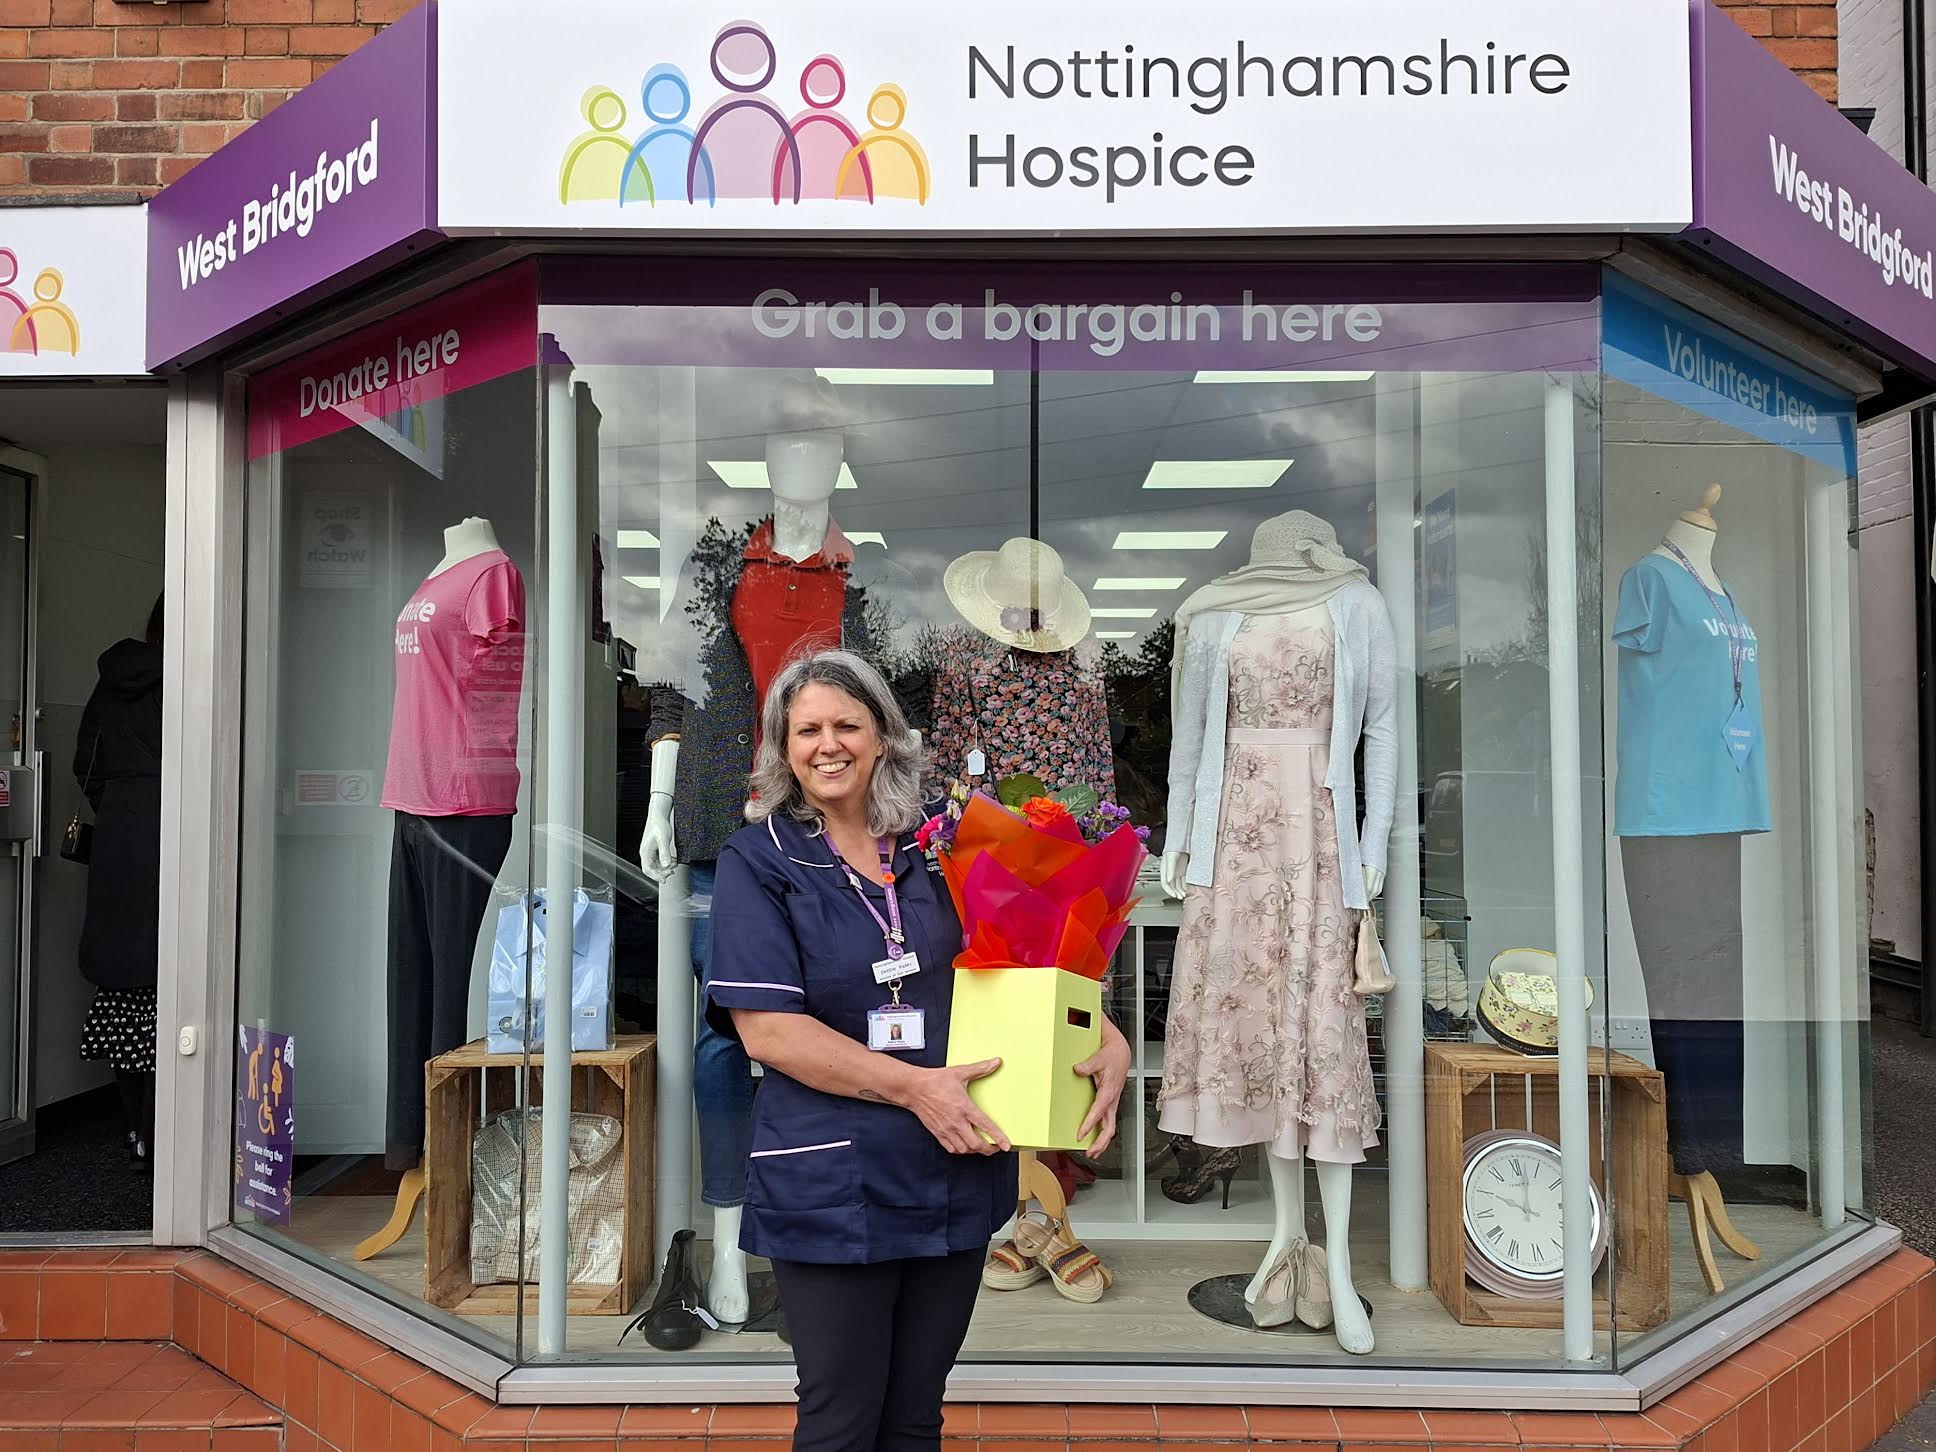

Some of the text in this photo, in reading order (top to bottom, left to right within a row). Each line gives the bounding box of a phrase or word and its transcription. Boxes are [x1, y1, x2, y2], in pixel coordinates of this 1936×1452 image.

[969, 39, 1570, 114] Nottinghamshire
[969, 132, 1254, 203] Hospice
[178, 118, 378, 290] West Bridgford
[1769, 134, 1933, 299] West Bridgford
[752, 287, 1383, 357] Grab a bargain here
[300, 329, 460, 418] Donate here
[1664, 324, 1817, 435] Volunteer here
[397, 598, 436, 622] nate
[246, 1140, 284, 1163] Please ring the
[254, 1160, 274, 1177] bell for
[248, 1178, 278, 1197] assistance.
